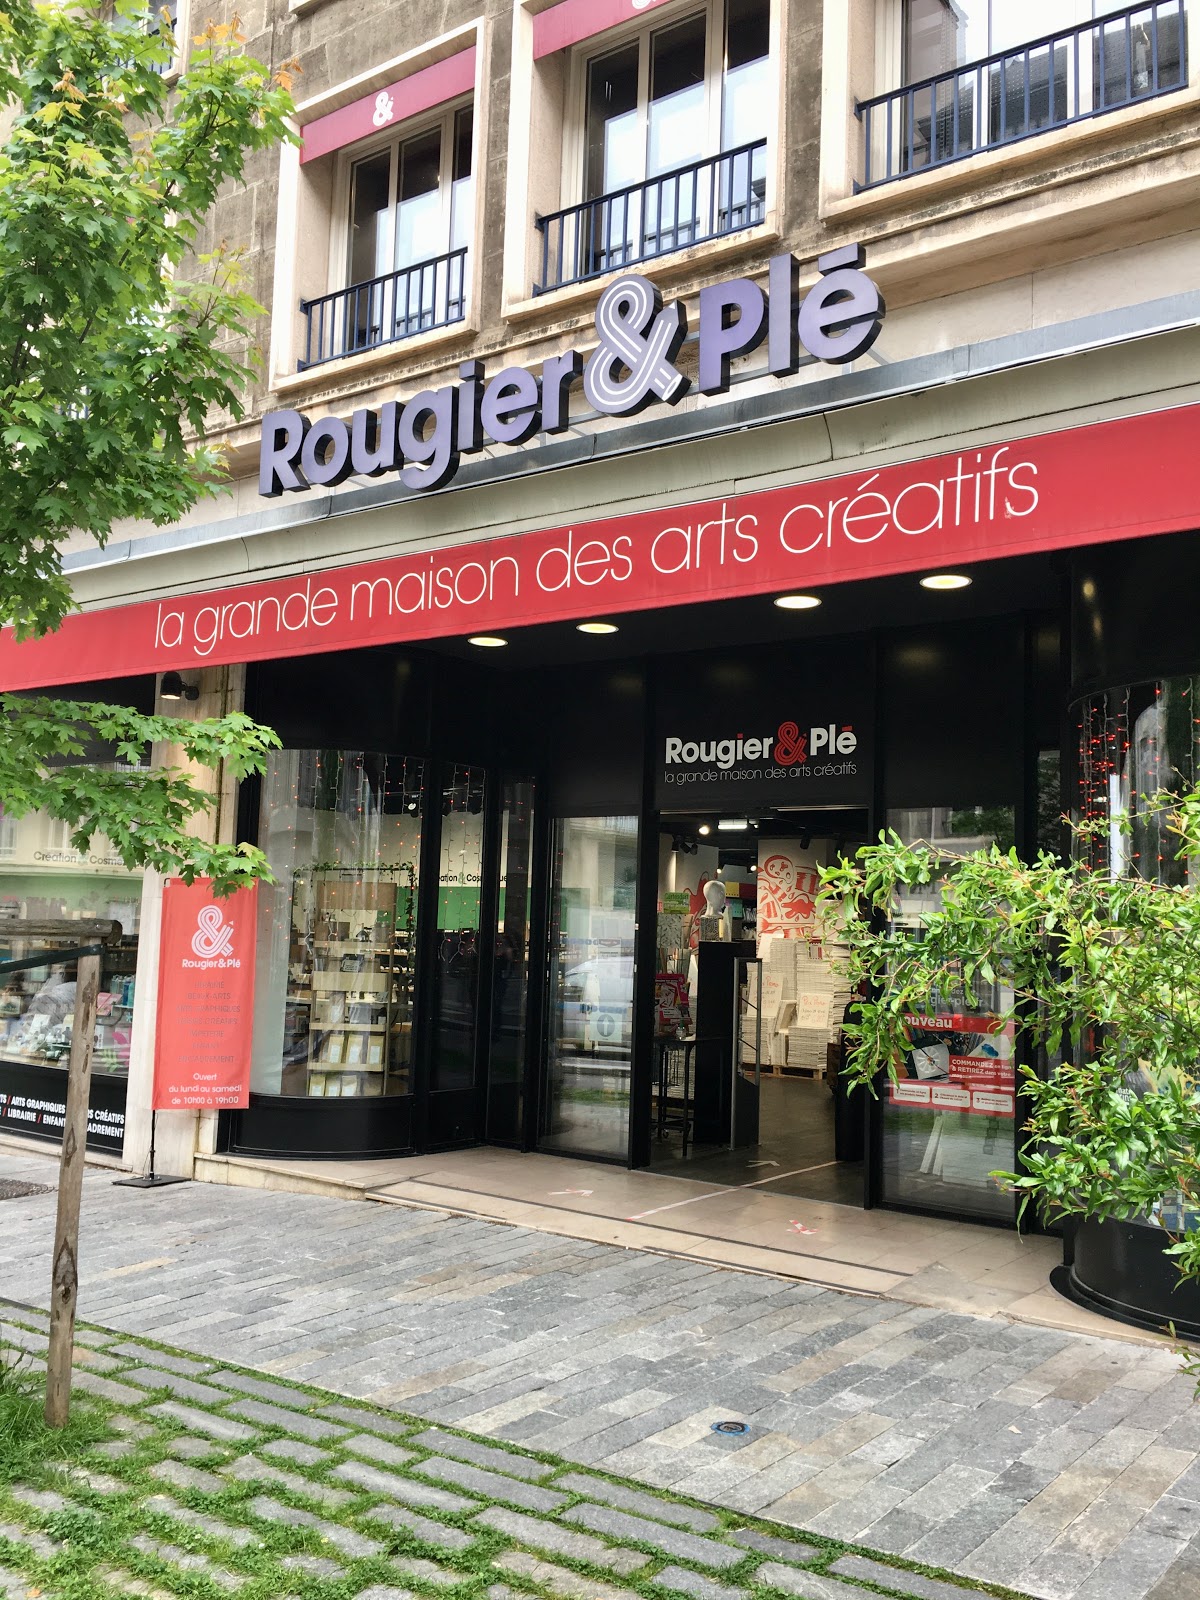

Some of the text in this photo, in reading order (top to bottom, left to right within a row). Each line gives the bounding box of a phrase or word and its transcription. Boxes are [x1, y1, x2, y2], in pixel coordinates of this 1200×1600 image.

[257, 349, 584, 497] Rougier
[700, 243, 886, 397] Plé
[154, 446, 1040, 656] la grande maison des arts créatifs
[665, 732, 774, 770] Rougier
[809, 723, 857, 756] Plé
[664, 761, 857, 786] la grande maison des arts créatifs
[951, 1059, 995, 1069] COMMANDEZ
[957, 1066, 985, 1075] RETIREZ
[193, 1072, 217, 1081] Ouvert
[180, 1085, 200, 1093] lundi
[211, 1084, 242, 1093] samedi
[11, 1096, 26, 1108] ARTS
[26, 1098, 66, 1114] GRAPHIQUES
[171, 1097, 181, 1105] de
[184, 1096, 205, 1104] 10h00
[215, 1096, 239, 1104] 19h00
[7, 1108, 37, 1122] LIBRAIRIE
[94, 1109, 125, 1125] CRÉATIFS
